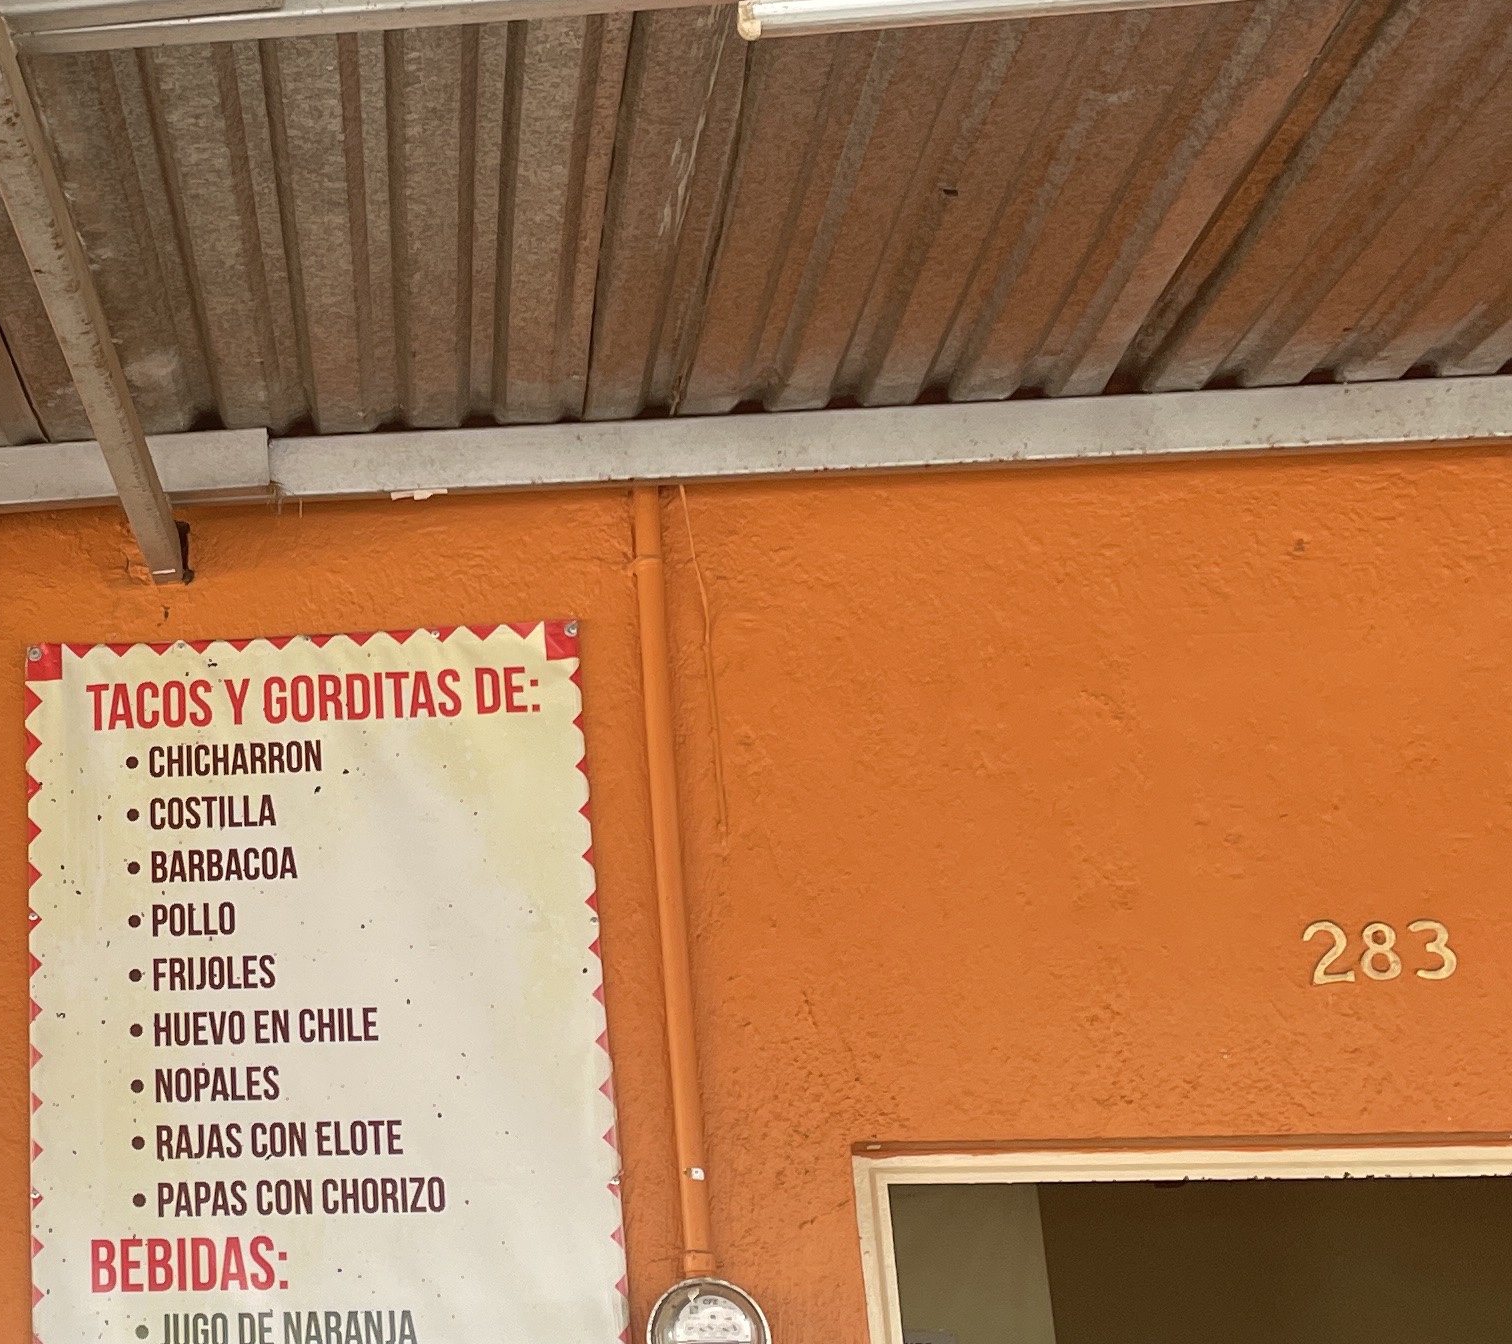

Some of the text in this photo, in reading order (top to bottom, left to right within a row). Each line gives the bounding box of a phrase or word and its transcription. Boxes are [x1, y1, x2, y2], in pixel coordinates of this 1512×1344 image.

[85, 666, 541, 731] TACOS Y GORDITAS DE:
[148, 740, 322, 778] CHICHARRON
[149, 795, 276, 830] COSTILLA
[150, 847, 297, 883] BARBACOA
[152, 902, 236, 937] POLLO
[1303, 919, 1457, 984] 283
[153, 955, 276, 991] FRIJOLES
[153, 1007, 378, 1047] HUEVO EN CHILE
[154, 1066, 280, 1103] NOPALES
[156, 1119, 404, 1160] RAJAS CON ELOTE
[157, 1176, 445, 1218] PAPAS CON CHORIZO
[91, 1236, 289, 1293] BEBIDAS:
